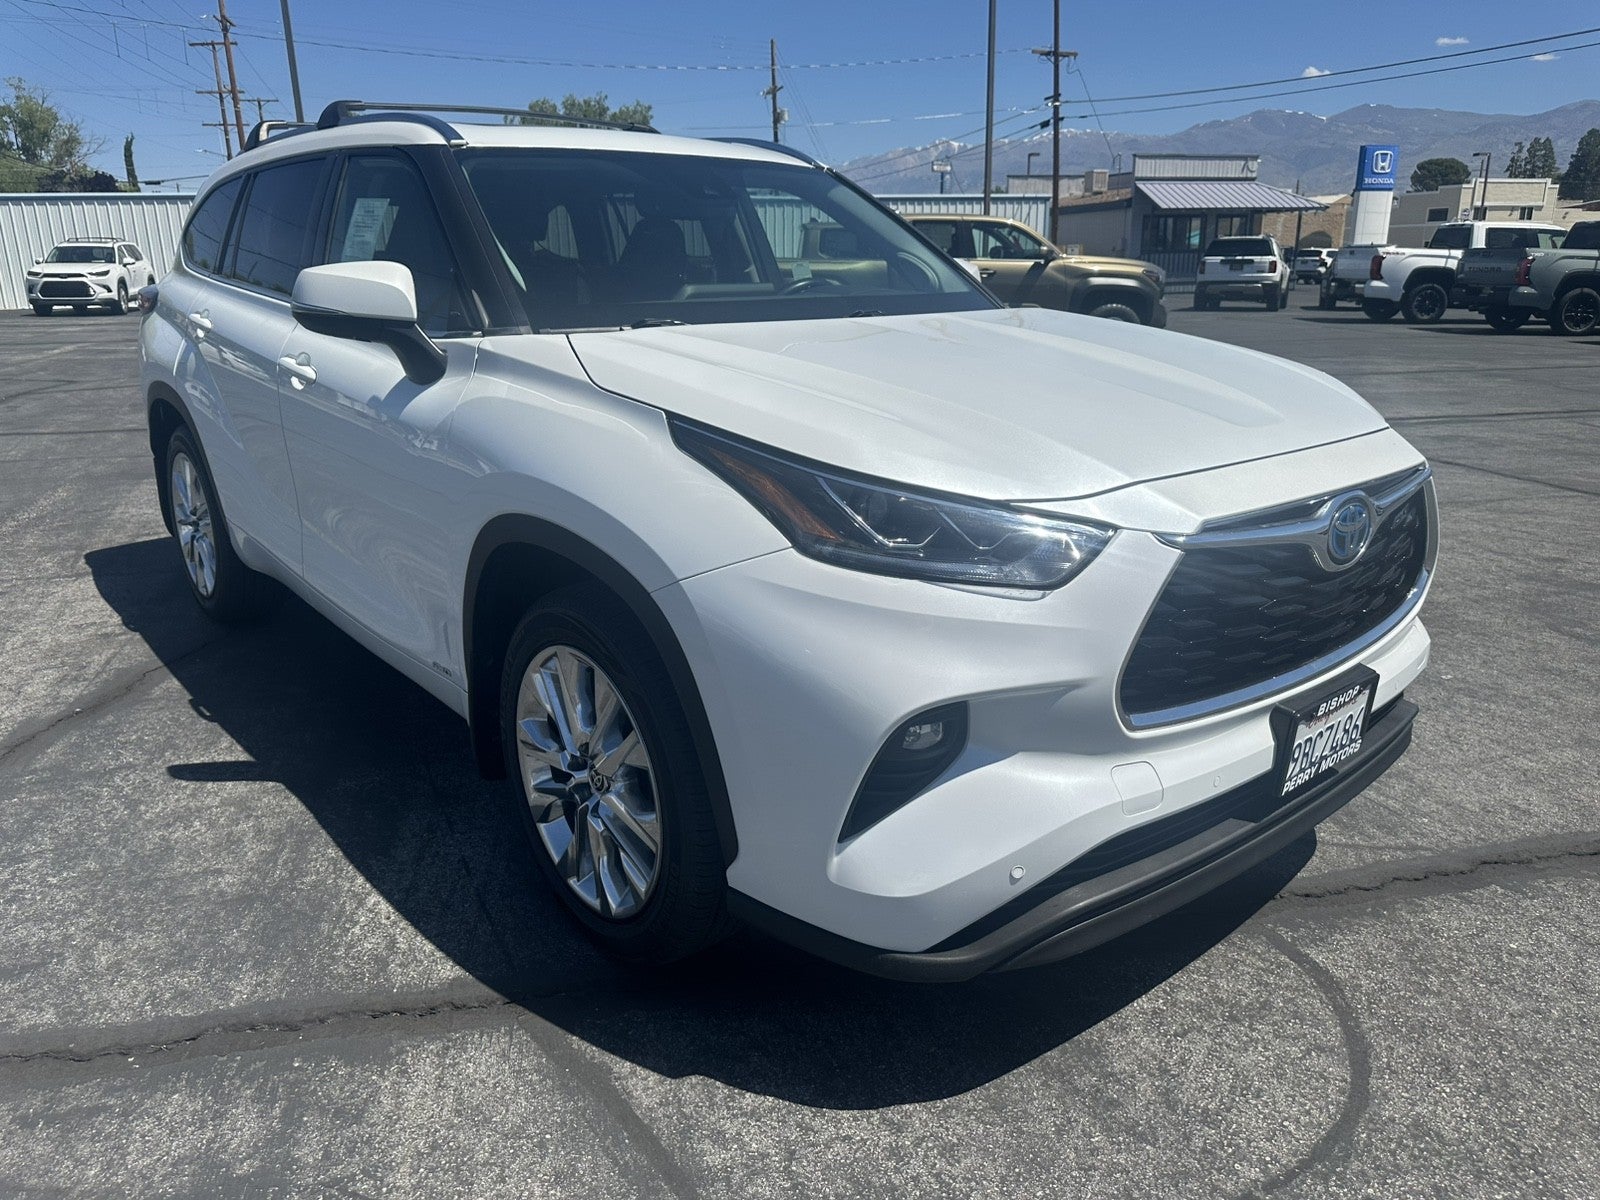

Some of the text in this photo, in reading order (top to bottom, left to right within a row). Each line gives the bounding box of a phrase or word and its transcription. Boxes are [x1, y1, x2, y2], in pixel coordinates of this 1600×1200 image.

[1317, 685, 1360, 717] BISHOP
[1281, 738, 1362, 796] PERRY MOTORS
